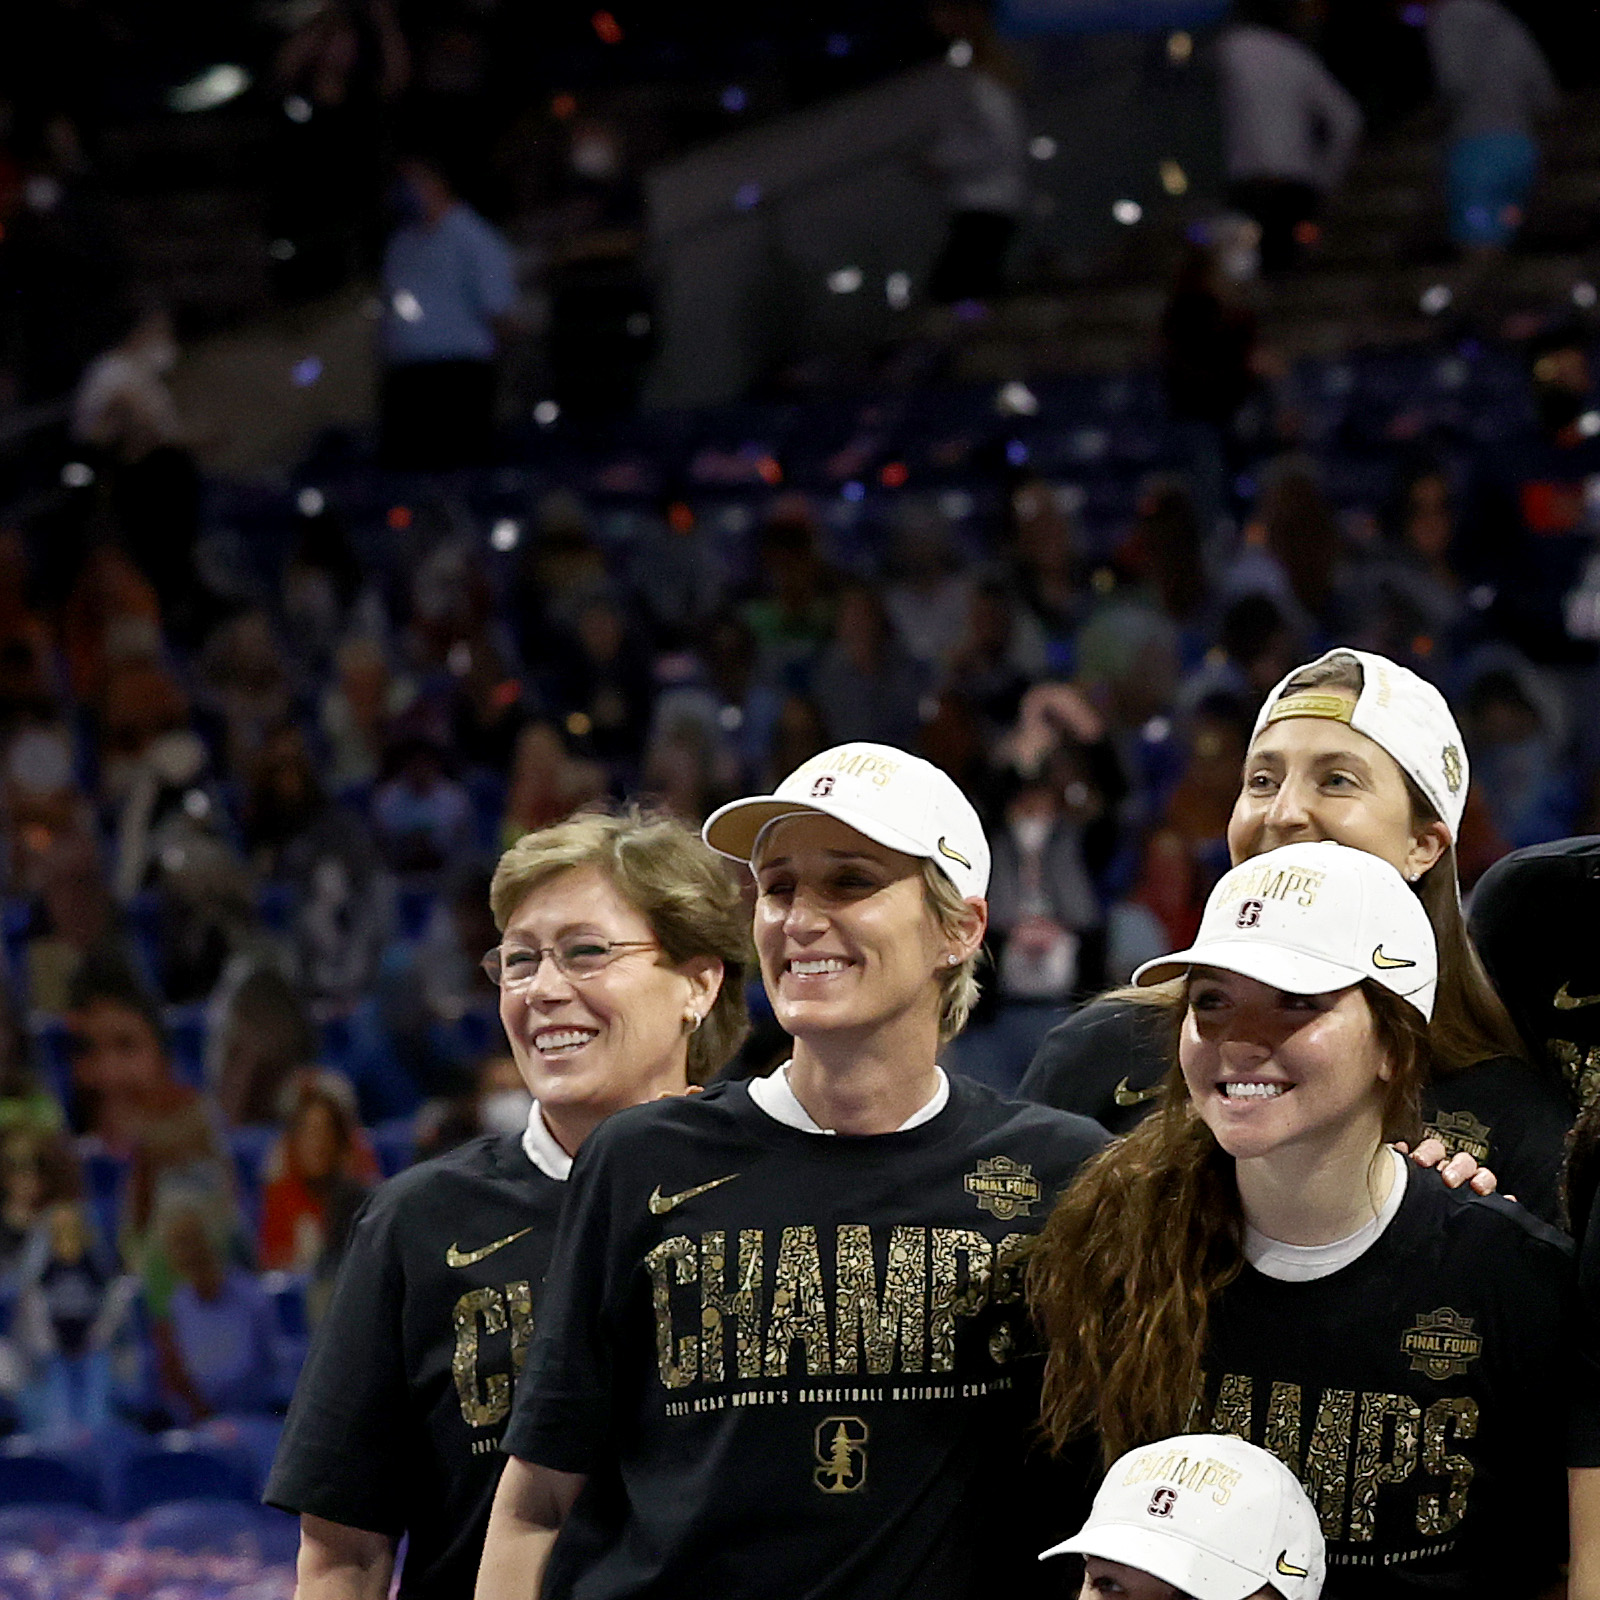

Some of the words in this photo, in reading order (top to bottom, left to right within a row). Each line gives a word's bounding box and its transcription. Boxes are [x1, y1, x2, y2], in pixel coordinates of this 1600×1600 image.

[968, 1176, 1004, 1192] FINAL
[1007, 1179, 1038, 1197] FOUR
[1405, 1333, 1440, 1351] FINAL
[1443, 1338, 1478, 1353] FOUR
[732, 1390, 788, 1407] WOMEN'S
[799, 1388, 883, 1403] BASKETBALL
